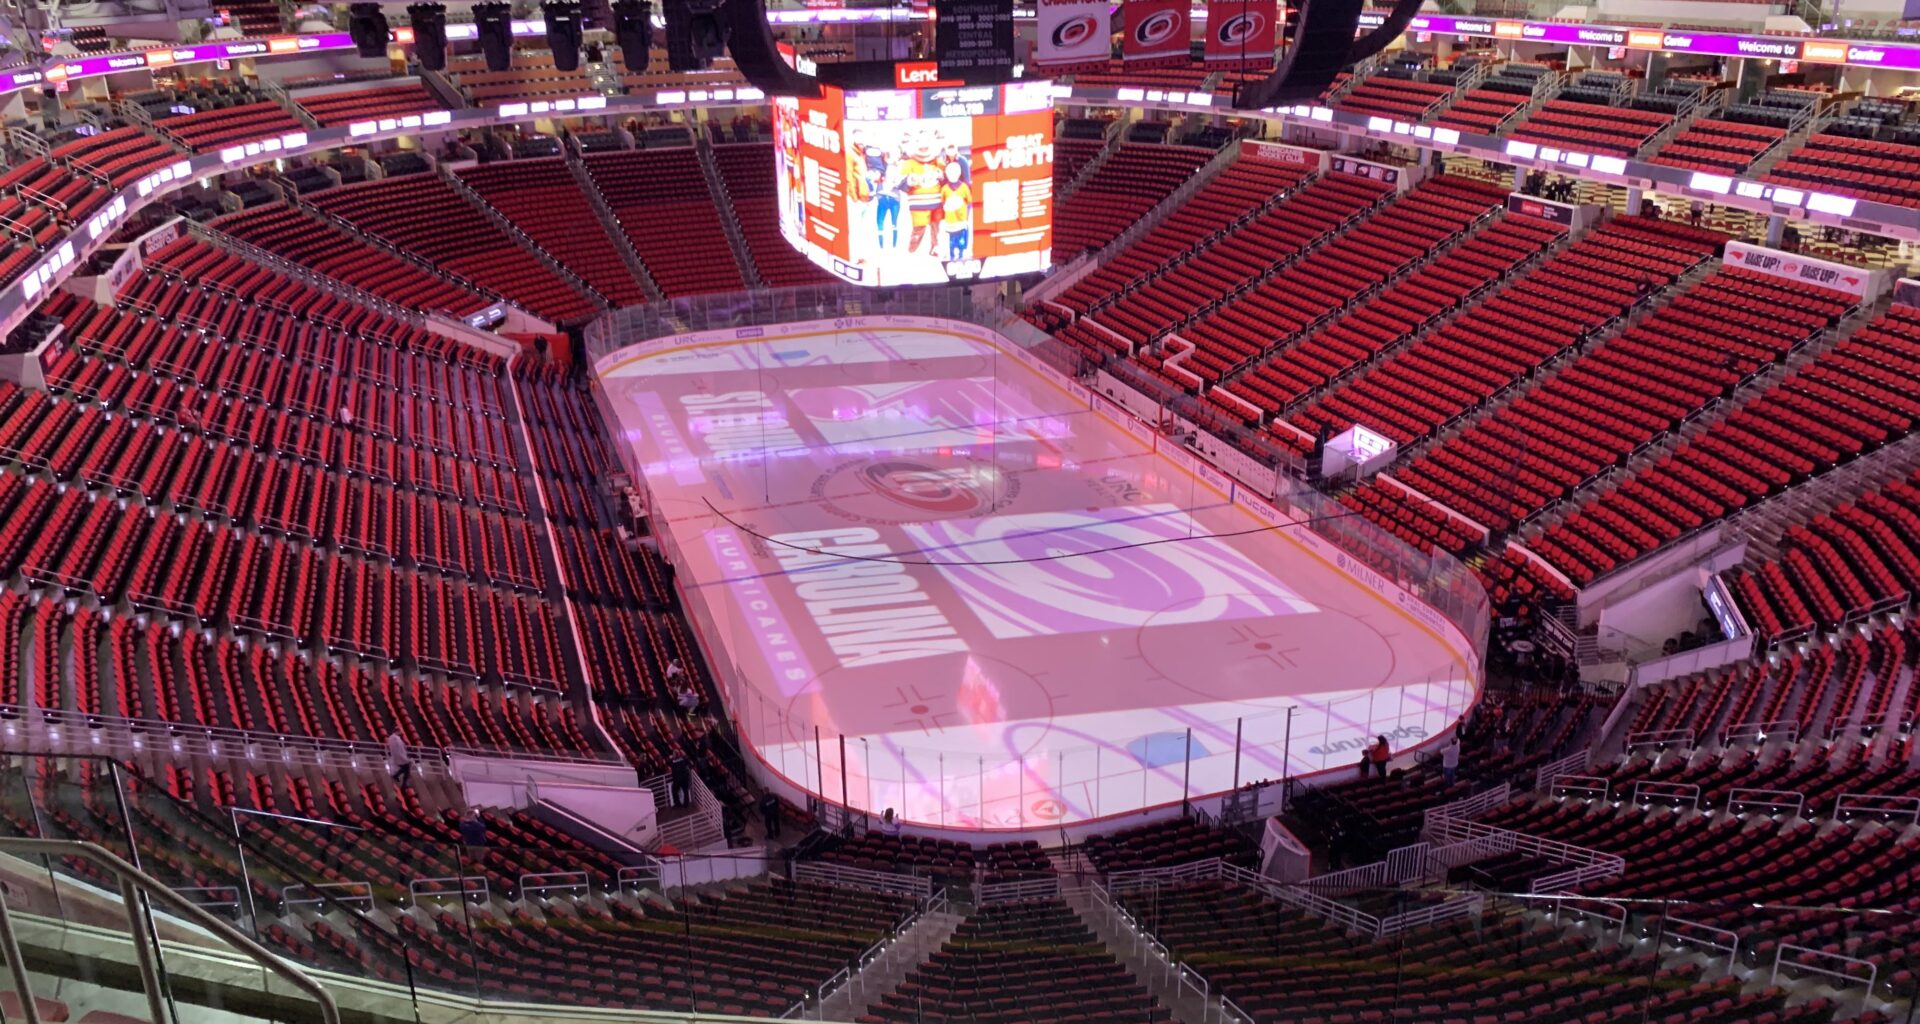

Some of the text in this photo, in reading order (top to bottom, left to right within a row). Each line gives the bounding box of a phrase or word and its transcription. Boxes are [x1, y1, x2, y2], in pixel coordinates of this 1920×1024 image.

[1455, 21, 1481, 32] Welcome
[1482, 23, 1491, 33] to
[1523, 25, 1545, 37] Center
[1578, 30, 1612, 43] Welcome
[1613, 32, 1623, 43] to
[1663, 35, 1691, 48] Center
[226, 43, 257, 54] Welcome
[1738, 40, 1885, 62] Welcome to Lenovo Center
[108, 56, 137, 68] Welcome
[900, 67, 937, 83] Leno
[1744, 252, 1839, 284] RAISE UP! RAISE UP!
[1237, 490, 1276, 521] NUCOR
[1347, 556, 1385, 591] MILNER
[714, 532, 806, 681] HURRICANES
[765, 527, 971, 668] CAROLINA
[1308, 726, 1429, 756] Sperum
